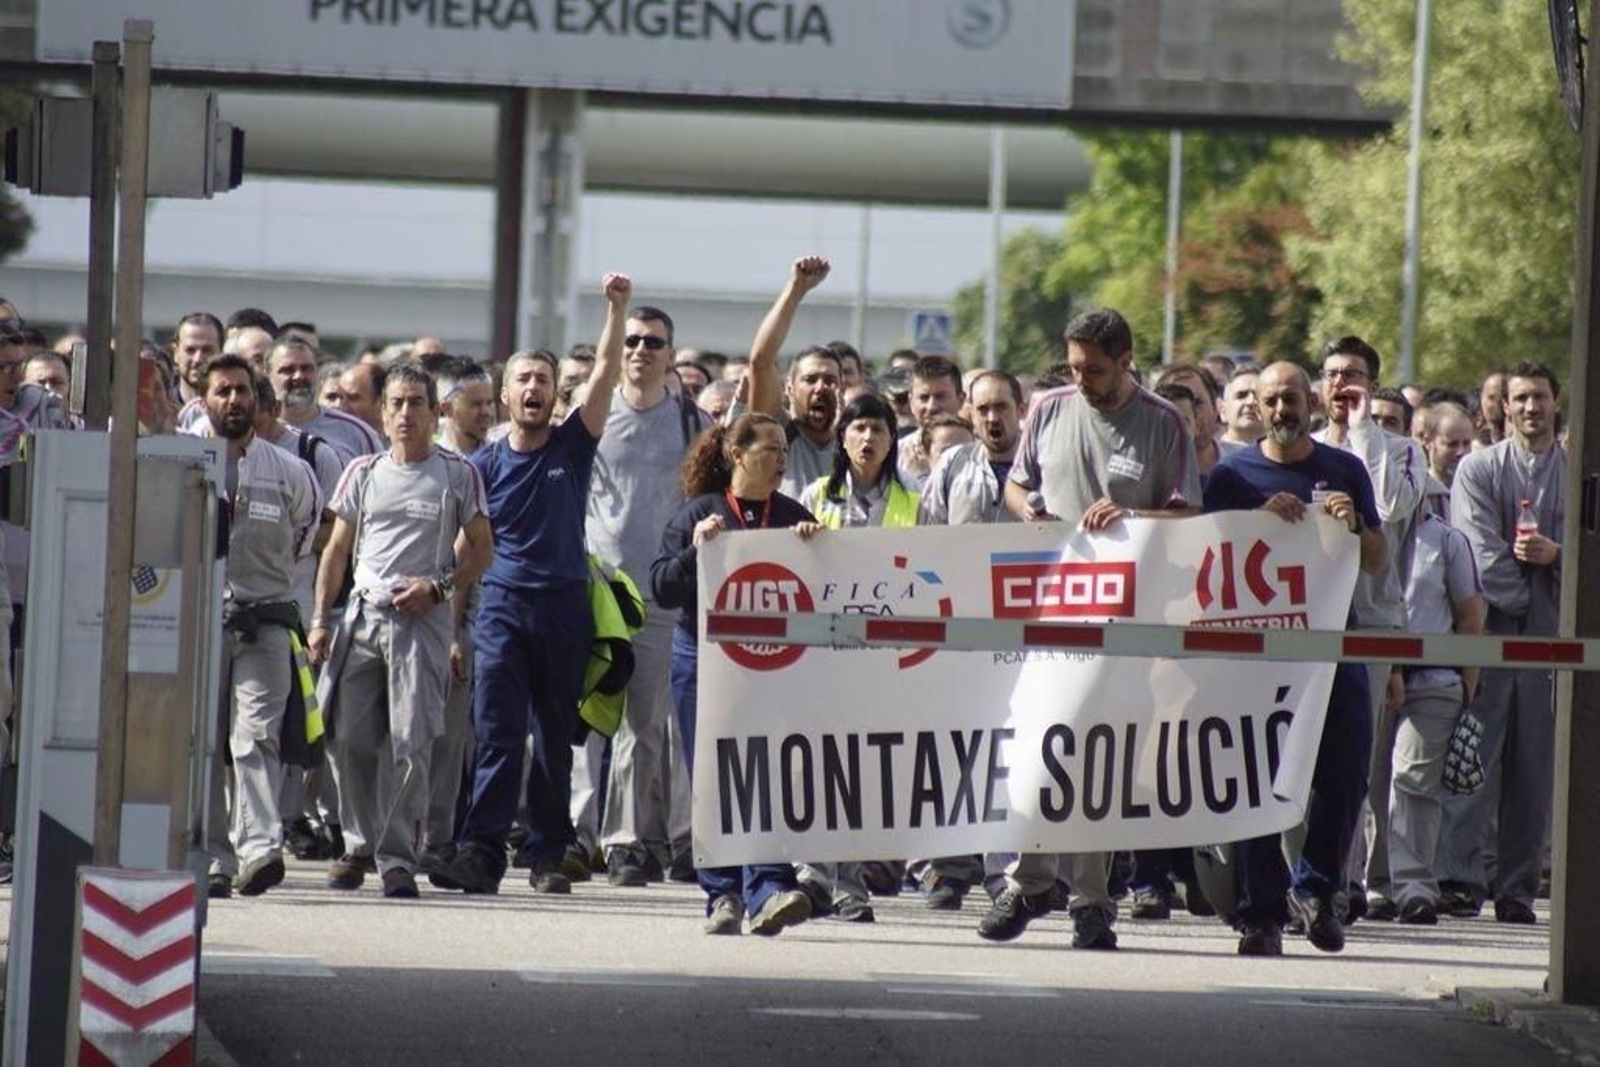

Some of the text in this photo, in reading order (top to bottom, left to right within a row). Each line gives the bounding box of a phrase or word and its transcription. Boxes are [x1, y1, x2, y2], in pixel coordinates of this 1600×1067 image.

[309, 0, 832, 45] PRIMERA EXIGENCIA
[725, 579, 800, 613] UGT
[1003, 573, 1126, 608] CCOO
[1191, 614, 1307, 630] STRIA
[716, 727, 1016, 835] MONTAXE
